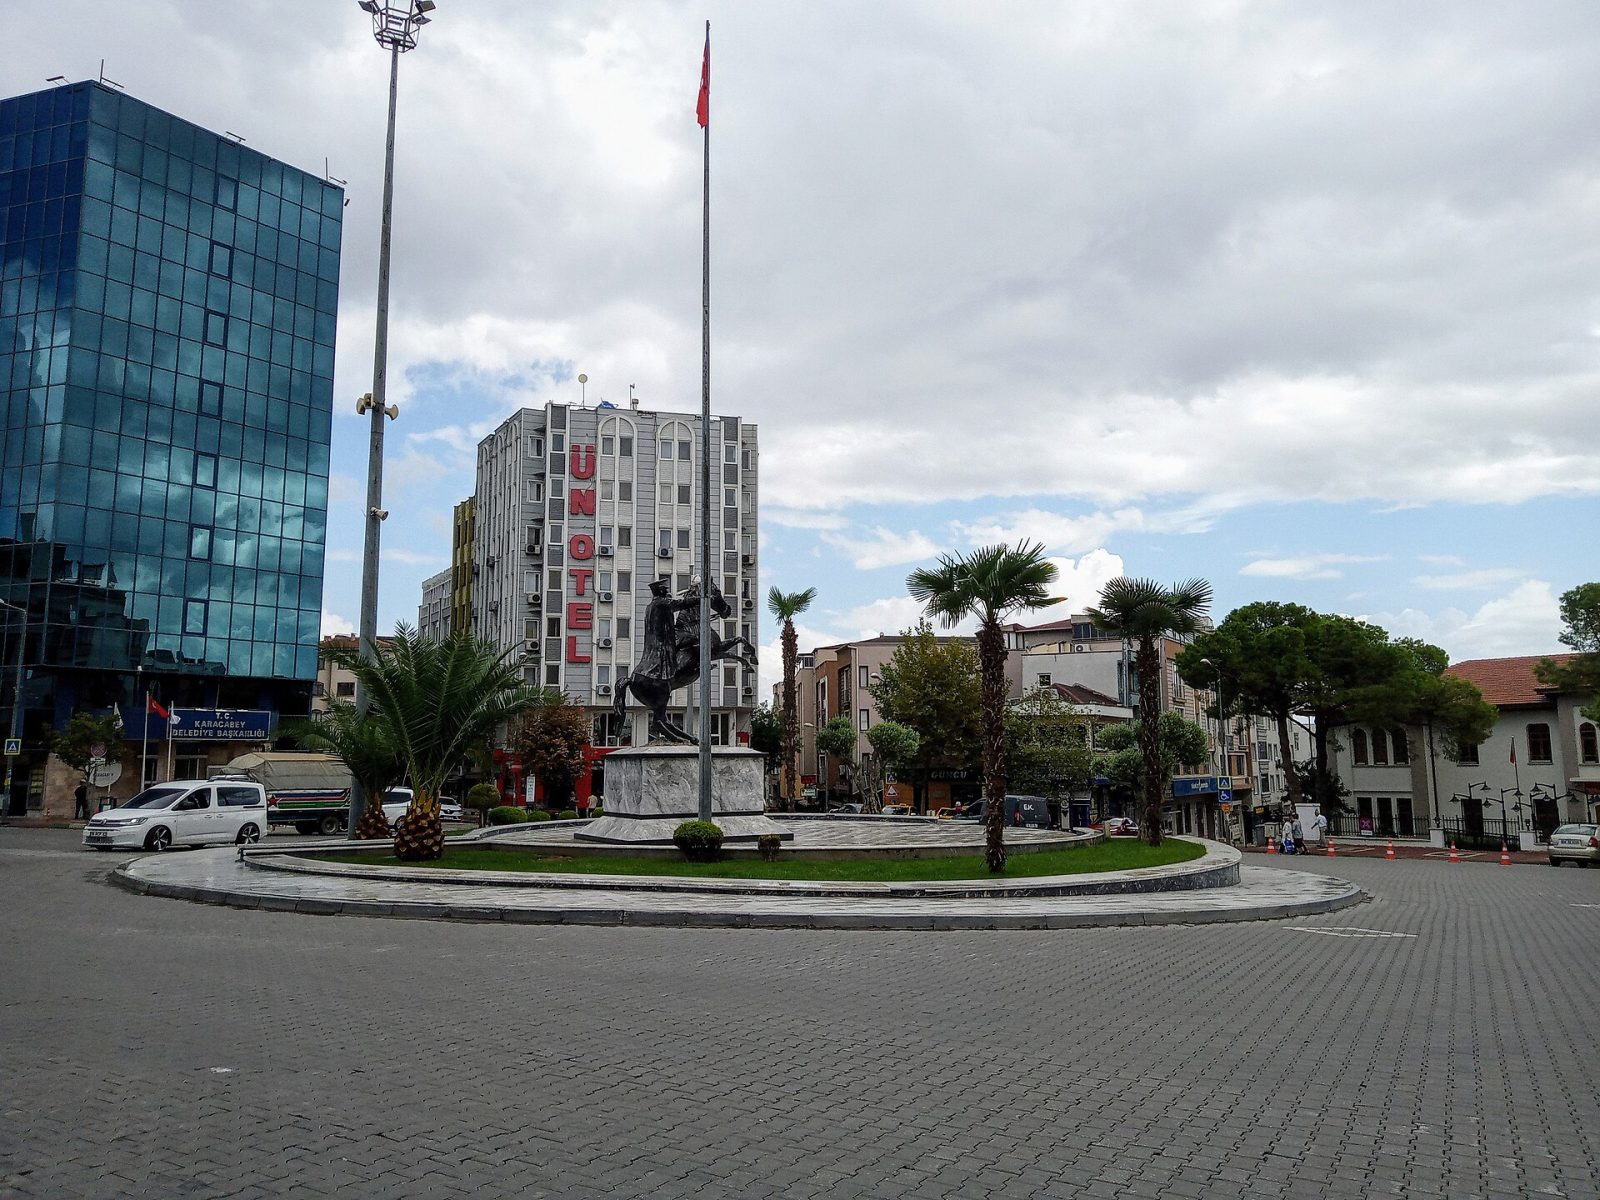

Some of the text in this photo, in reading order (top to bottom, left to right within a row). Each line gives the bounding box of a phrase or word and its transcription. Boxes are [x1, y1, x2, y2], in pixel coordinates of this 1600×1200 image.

[567, 444, 596, 664] ÜN OTEL
[194, 720, 246, 728] KARACABEY
[172, 728, 265, 738] BELEDİYE BAŞKANLIĞI
